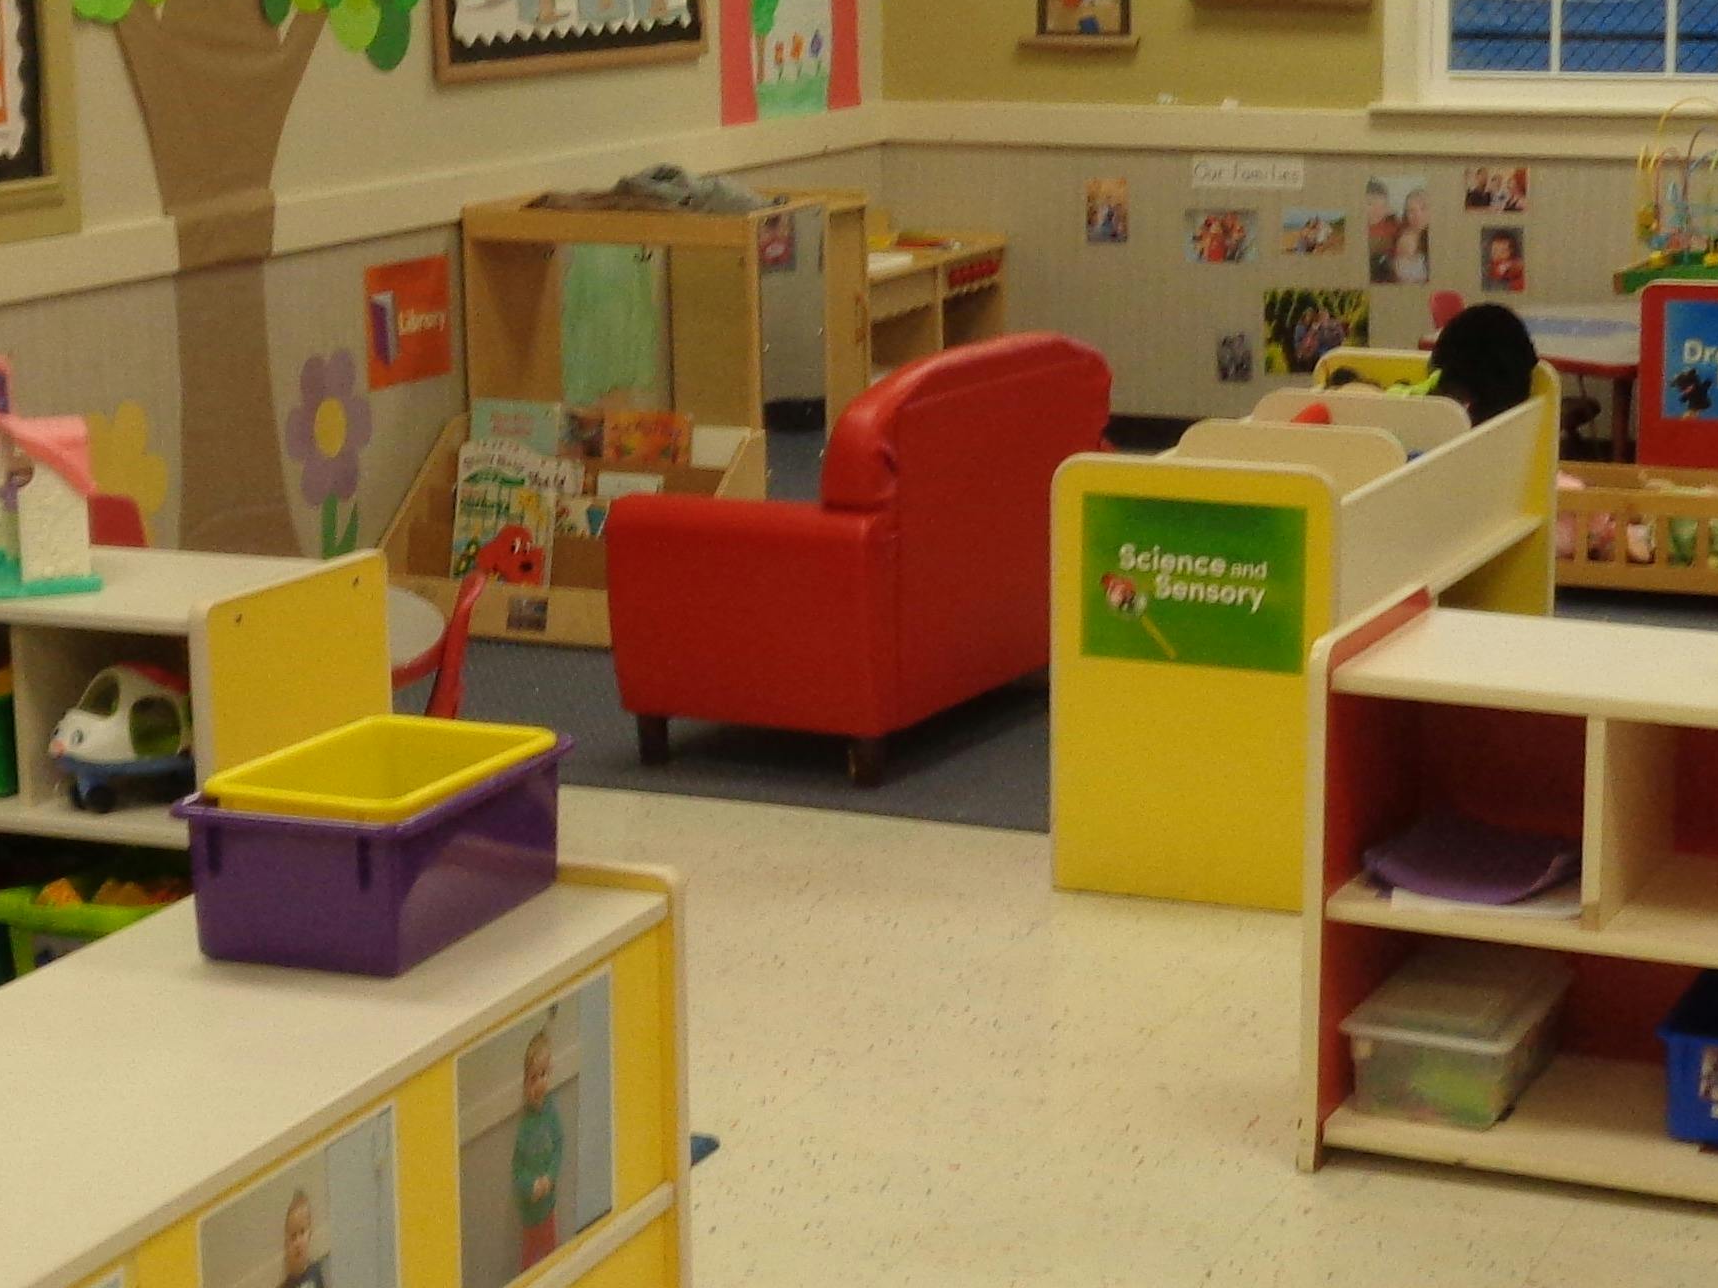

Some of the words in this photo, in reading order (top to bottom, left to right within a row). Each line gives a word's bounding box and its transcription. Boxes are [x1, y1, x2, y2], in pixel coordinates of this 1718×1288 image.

[1119, 543, 1227, 577] Science
[1229, 561, 1269, 581] and
[1154, 573, 1266, 615] Sensory
